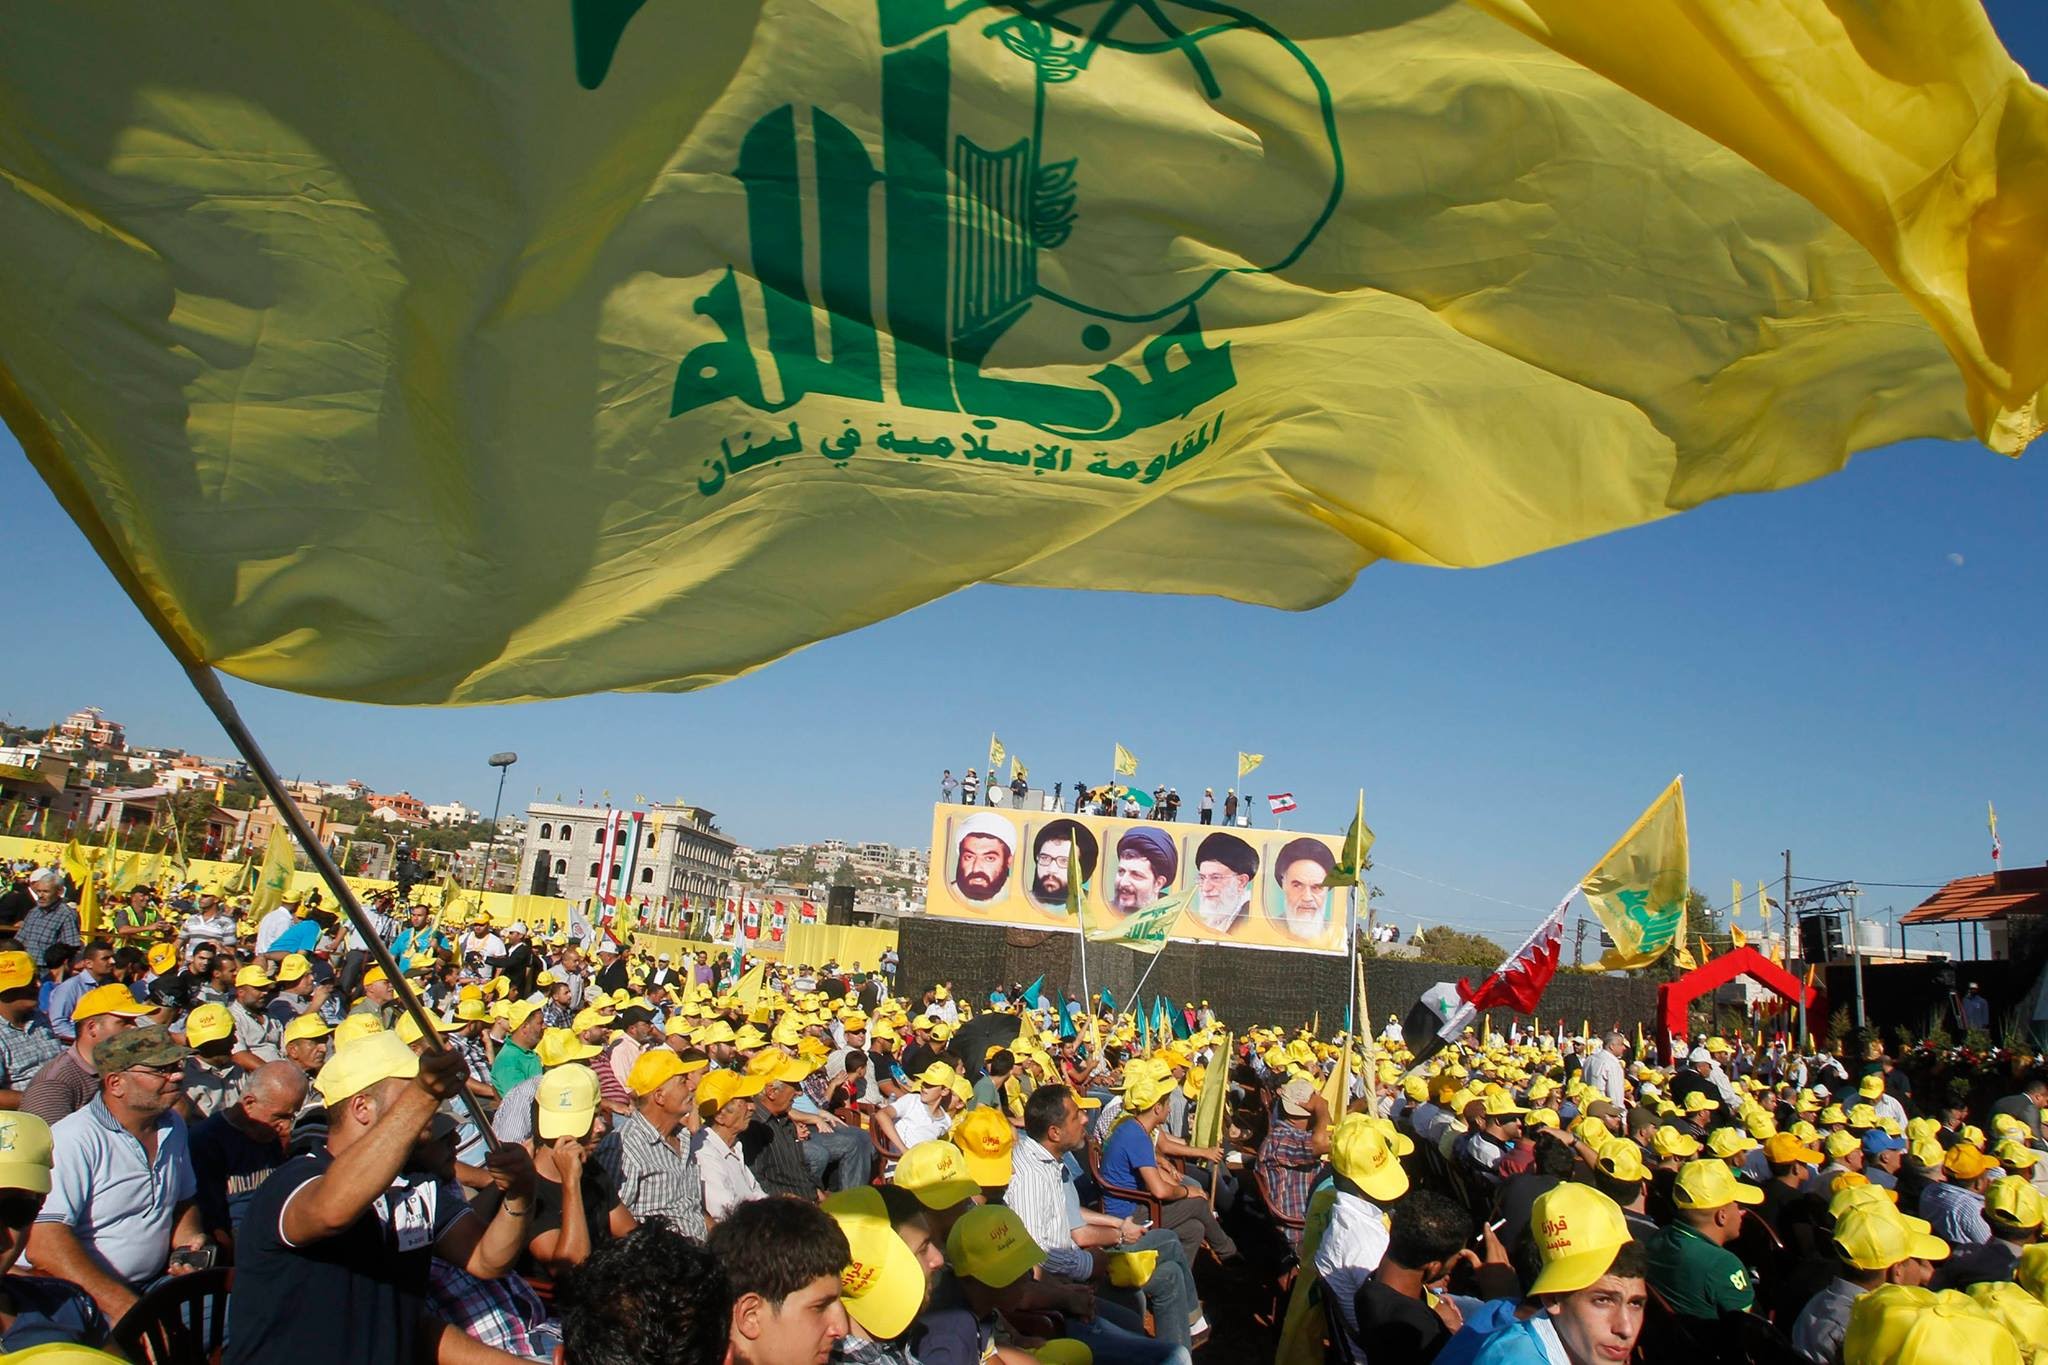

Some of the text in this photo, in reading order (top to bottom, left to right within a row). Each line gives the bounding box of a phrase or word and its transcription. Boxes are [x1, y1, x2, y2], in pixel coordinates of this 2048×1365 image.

[697, 409, 1225, 496] المقاومة الإسلامية في لبنان
[1541, 1215, 1568, 1237] قرارنا
[1729, 1269, 1747, 1290] 87
